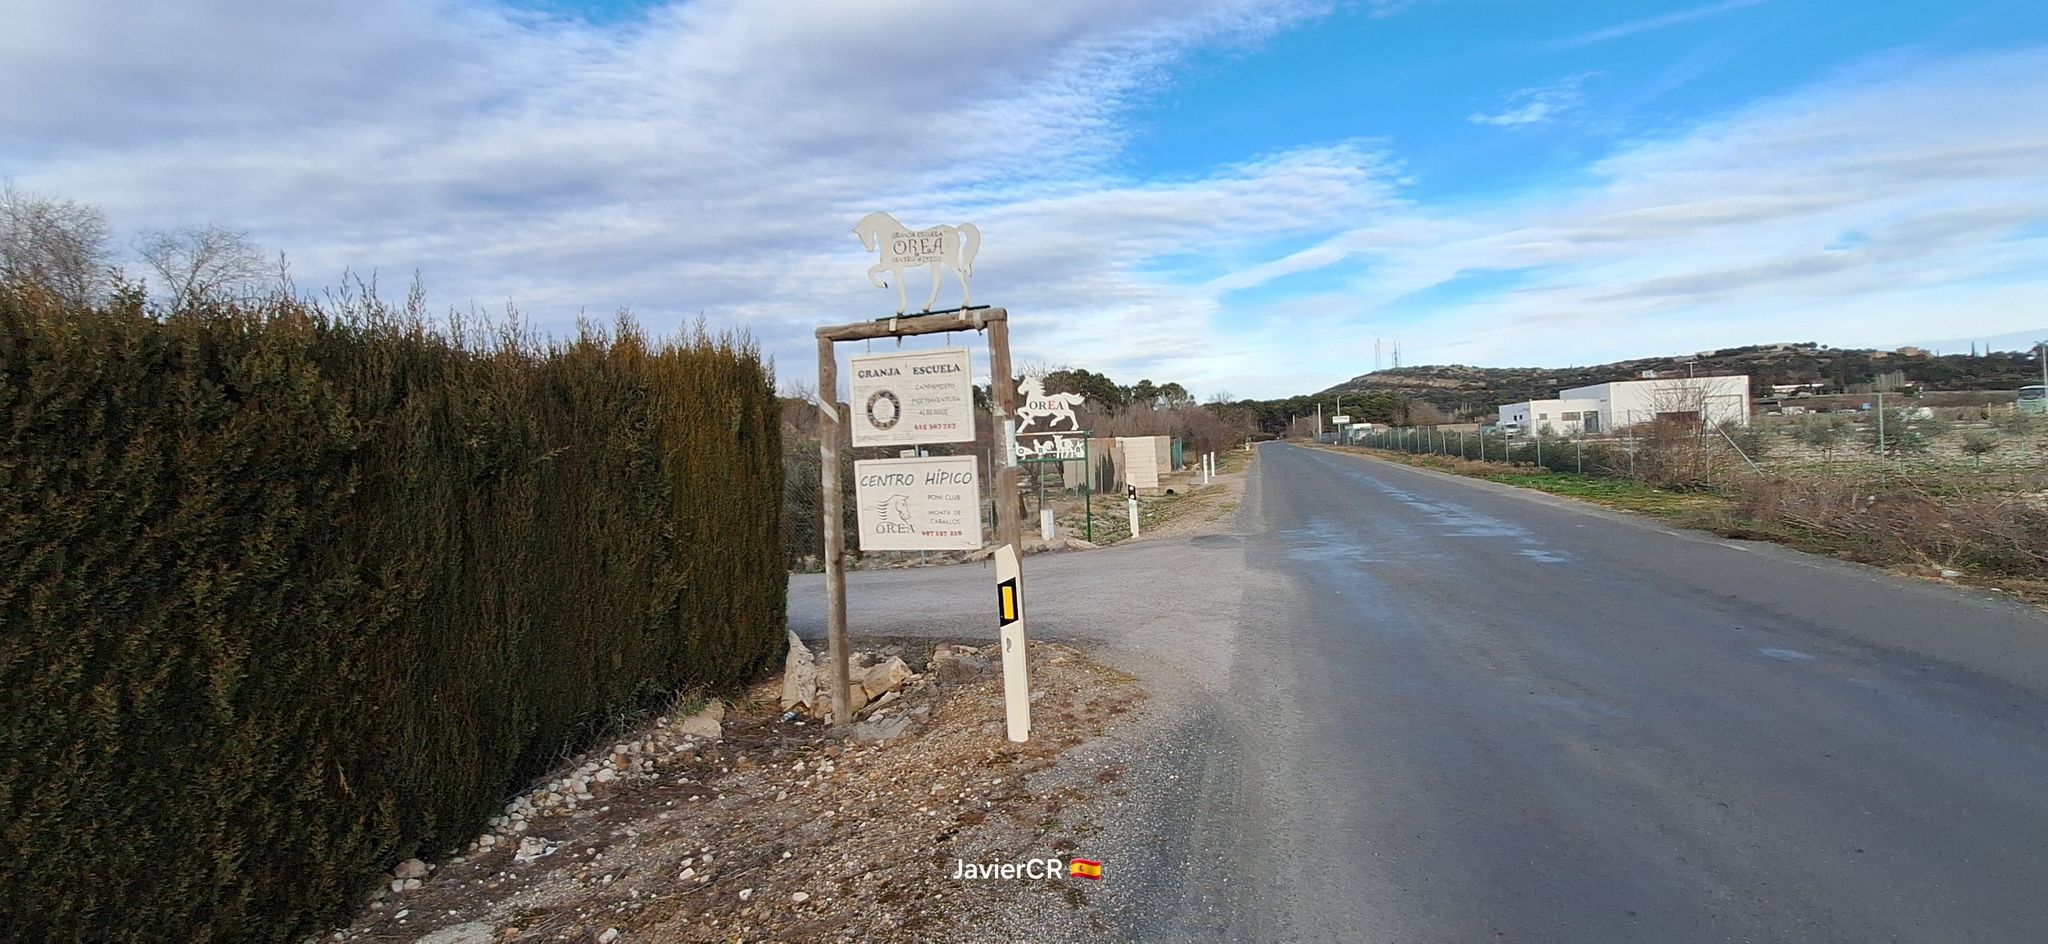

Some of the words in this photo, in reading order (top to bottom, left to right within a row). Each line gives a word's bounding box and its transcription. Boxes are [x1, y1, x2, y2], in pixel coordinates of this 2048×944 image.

[893, 237, 944, 257] OREA
[858, 367, 901, 379] GRANJA
[912, 364, 961, 375] ESCUELA
[914, 382, 956, 391] CAMPAMENTO
[1029, 400, 1064, 410] OREA
[860, 473, 915, 487] CENTRO
[924, 468, 973, 485] HÍPICO
[875, 523, 915, 534] OREA
